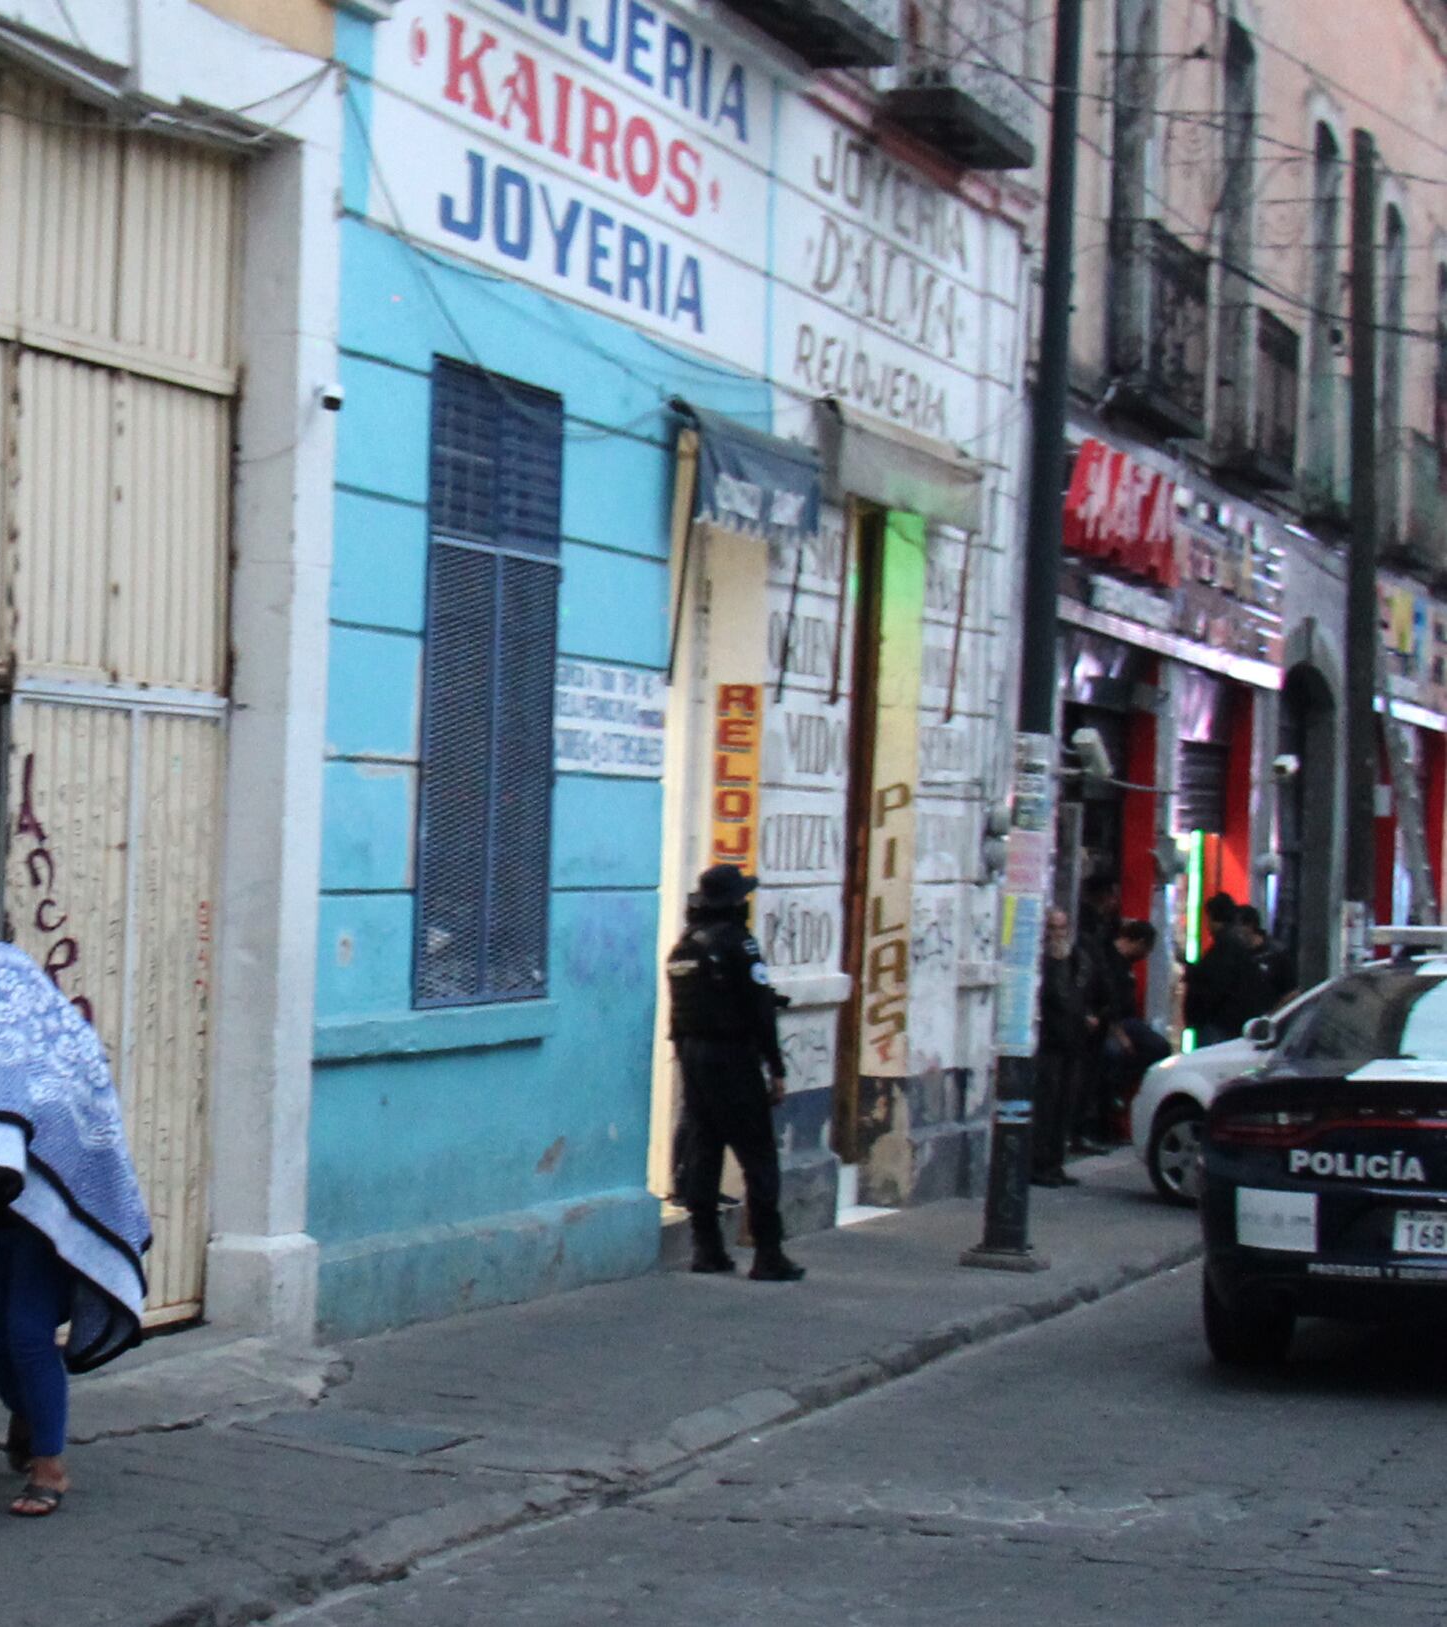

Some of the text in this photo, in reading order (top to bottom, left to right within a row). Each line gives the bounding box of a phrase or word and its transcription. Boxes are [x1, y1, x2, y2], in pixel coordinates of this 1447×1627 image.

[442, 12, 703, 218] KAIROS
[815, 129, 967, 272] JOYERIA
[438, 149, 706, 334] JOYERIA
[793, 322, 947, 437] RELOJERIA
[712, 683, 757, 868] RELOJ
[866, 782, 910, 1045] PILAS
[1289, 1149, 1426, 1183] POLICÍA
